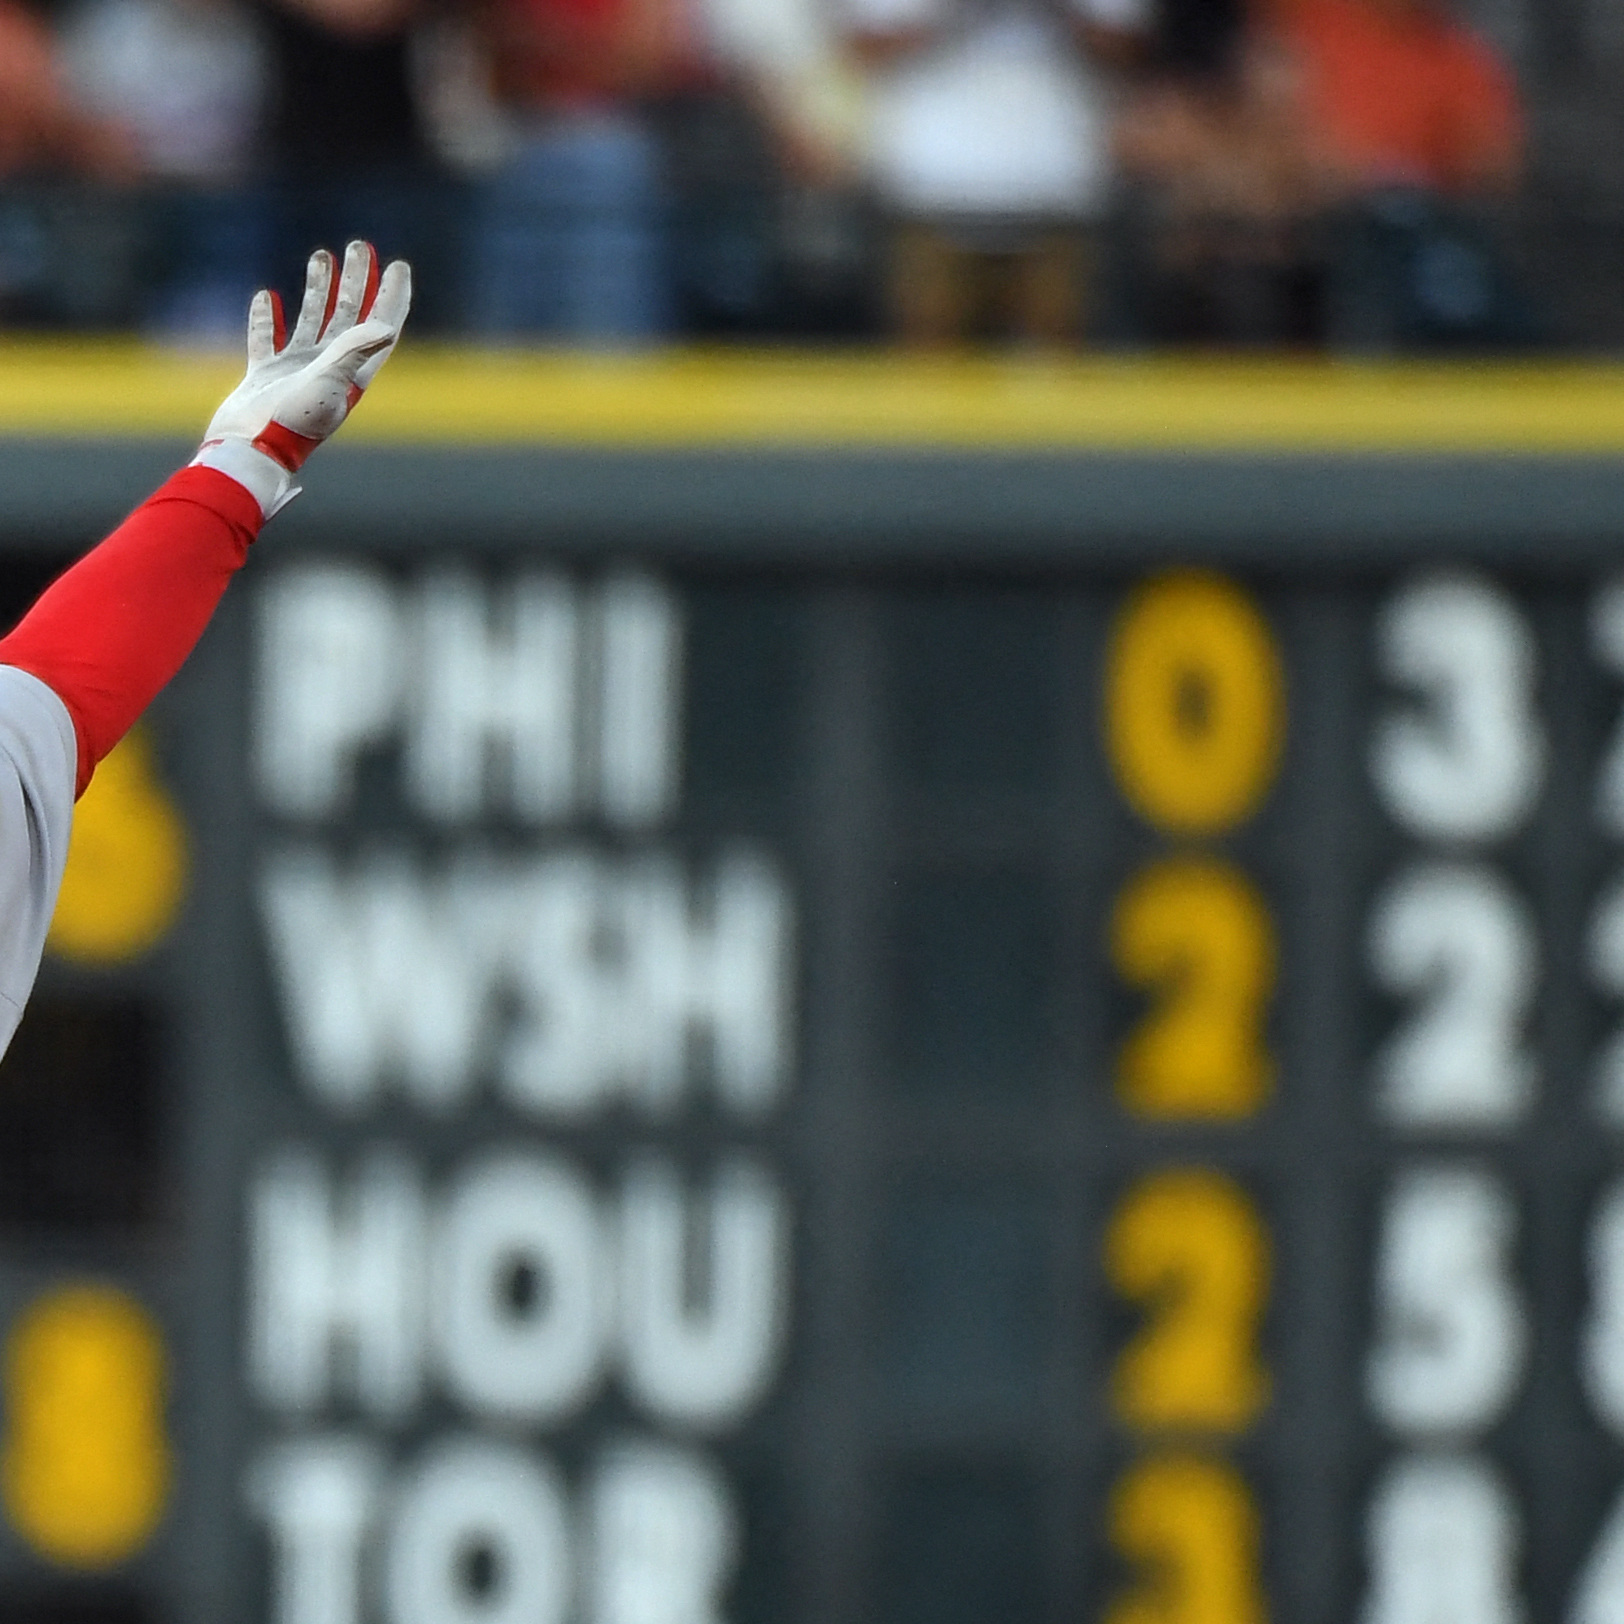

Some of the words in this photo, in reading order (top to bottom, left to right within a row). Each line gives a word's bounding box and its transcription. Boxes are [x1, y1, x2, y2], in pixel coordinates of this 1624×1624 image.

[254, 562, 677, 820] PHI
[1105, 570, 1282, 833] 0
[1372, 575, 1544, 840] 3
[260, 848, 792, 1112] WSH
[1112, 860, 1274, 1120] 2
[1370, 865, 1537, 1123] 2
[2, 1285, 170, 1567] 8
[252, 1152, 784, 1425] HOU
[1107, 1168, 1269, 1432] 2
[1370, 1170, 1524, 1435] 5
